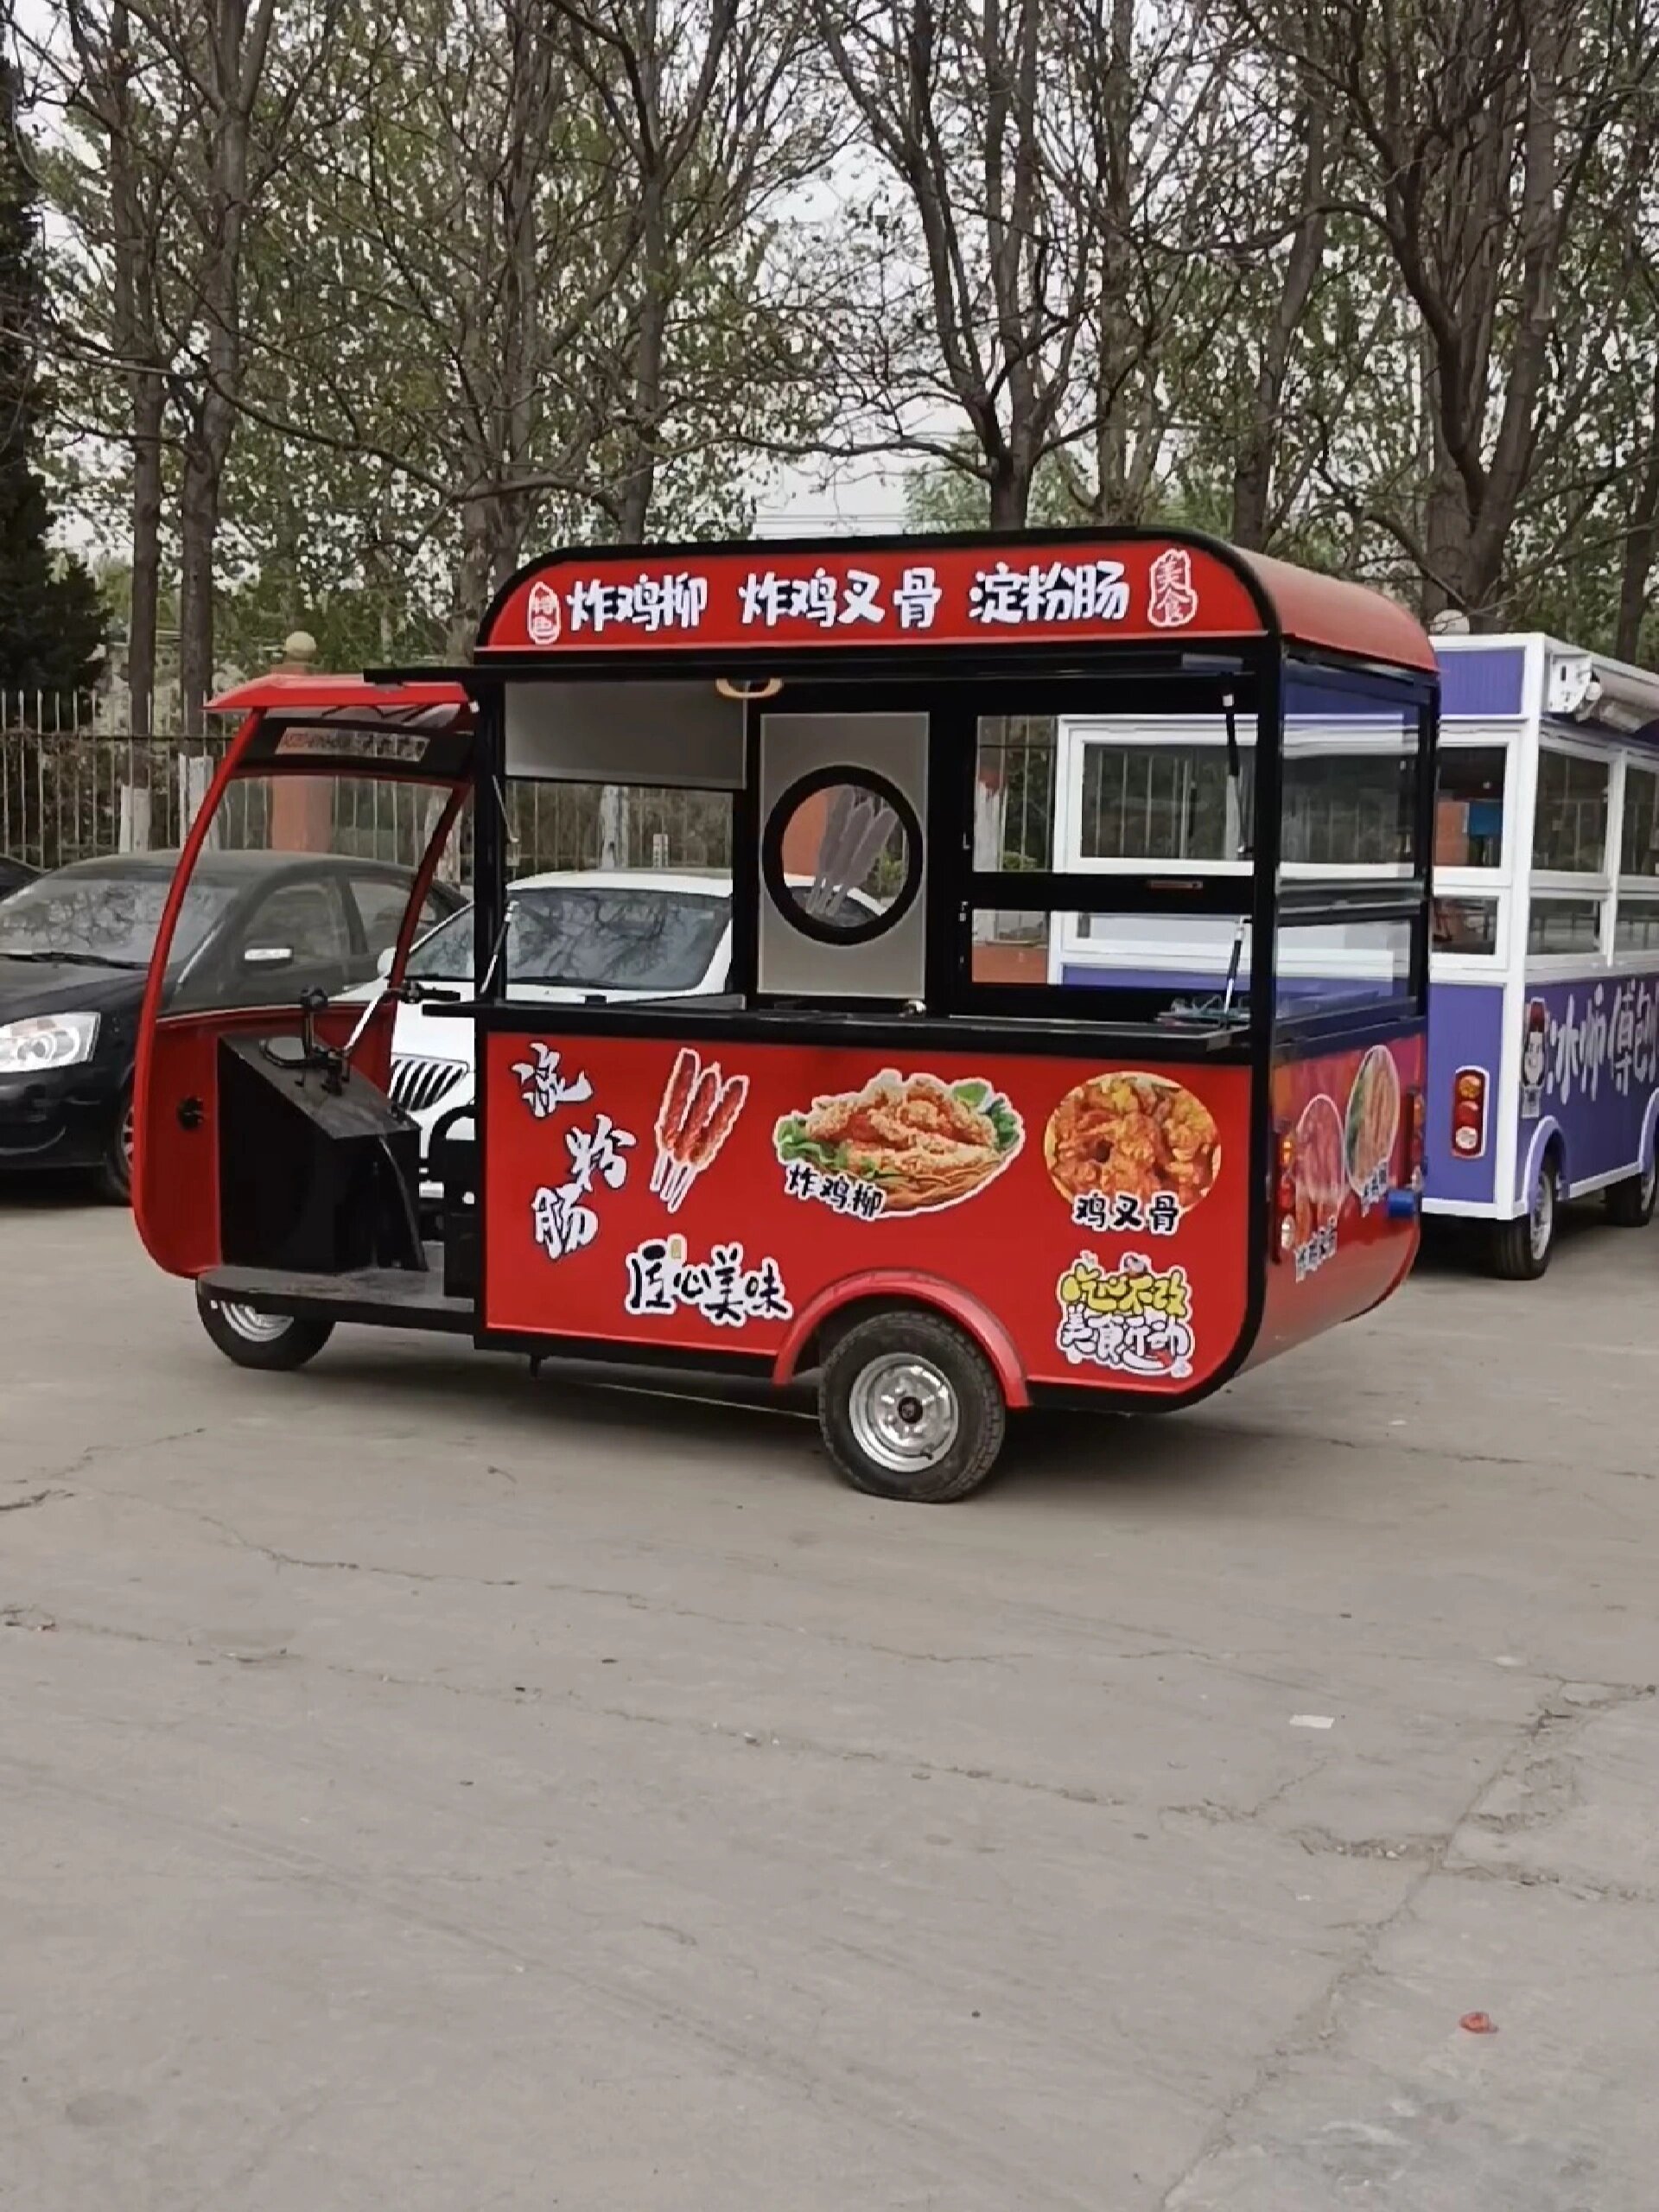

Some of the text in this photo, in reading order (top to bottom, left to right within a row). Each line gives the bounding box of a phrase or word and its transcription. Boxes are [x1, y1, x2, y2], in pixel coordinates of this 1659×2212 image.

[567, 561, 1130, 632] 炸鸡柳 炸鸡叉骨 淀粉肠
[787, 1164, 884, 1219] 炸鸡柳
[1075, 1195, 1180, 1232] 鸡叉骨
[627, 1241, 790, 1325] 匠心美味
